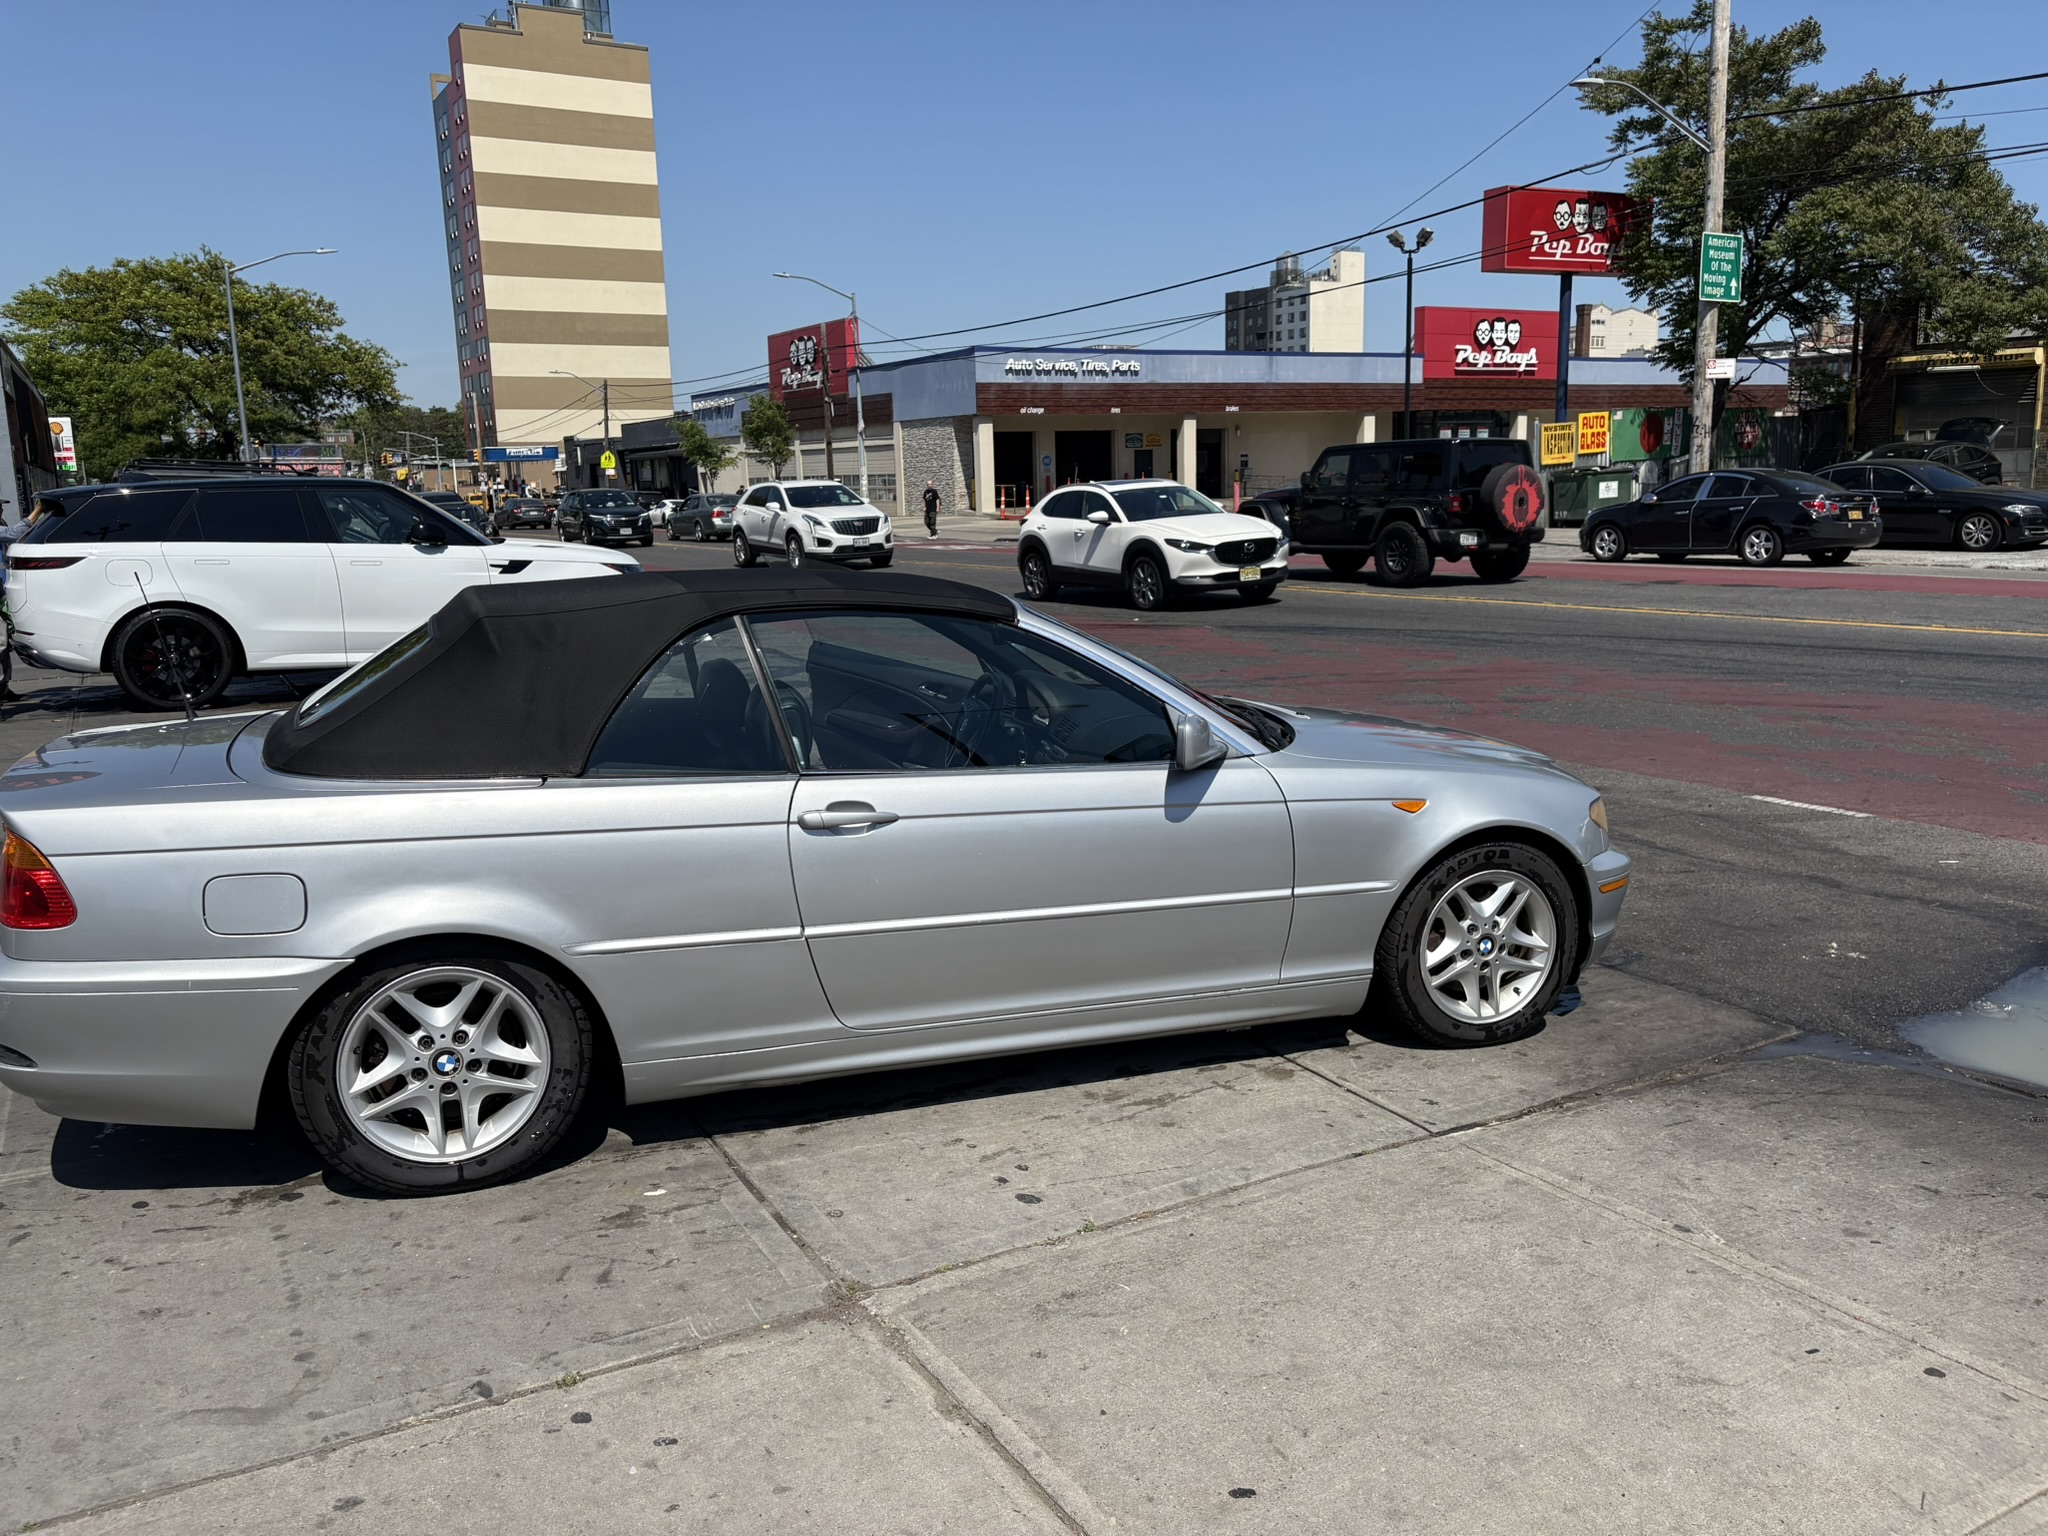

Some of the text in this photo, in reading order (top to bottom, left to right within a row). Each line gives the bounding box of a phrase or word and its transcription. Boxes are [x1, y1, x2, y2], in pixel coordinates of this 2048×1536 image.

[1528, 230, 1572, 259] Pep
[1707, 236, 1738, 248] American
[1708, 249, 1735, 260] Museum
[1711, 261, 1732, 272] Of The
[1703, 273, 1727, 286] Moving
[1704, 285, 1725, 298] Image
[1454, 344, 1538, 372] Pep Boys
[1982, 353, 2024, 363] SHOP
[1005, 358, 1141, 373] Auto Service, Tires, Parts
[780, 365, 824, 389] Pep Boy
[1554, 424, 1572, 432] STATE
[1582, 415, 1606, 430] AUTO
[1580, 431, 1607, 450] GLASS
